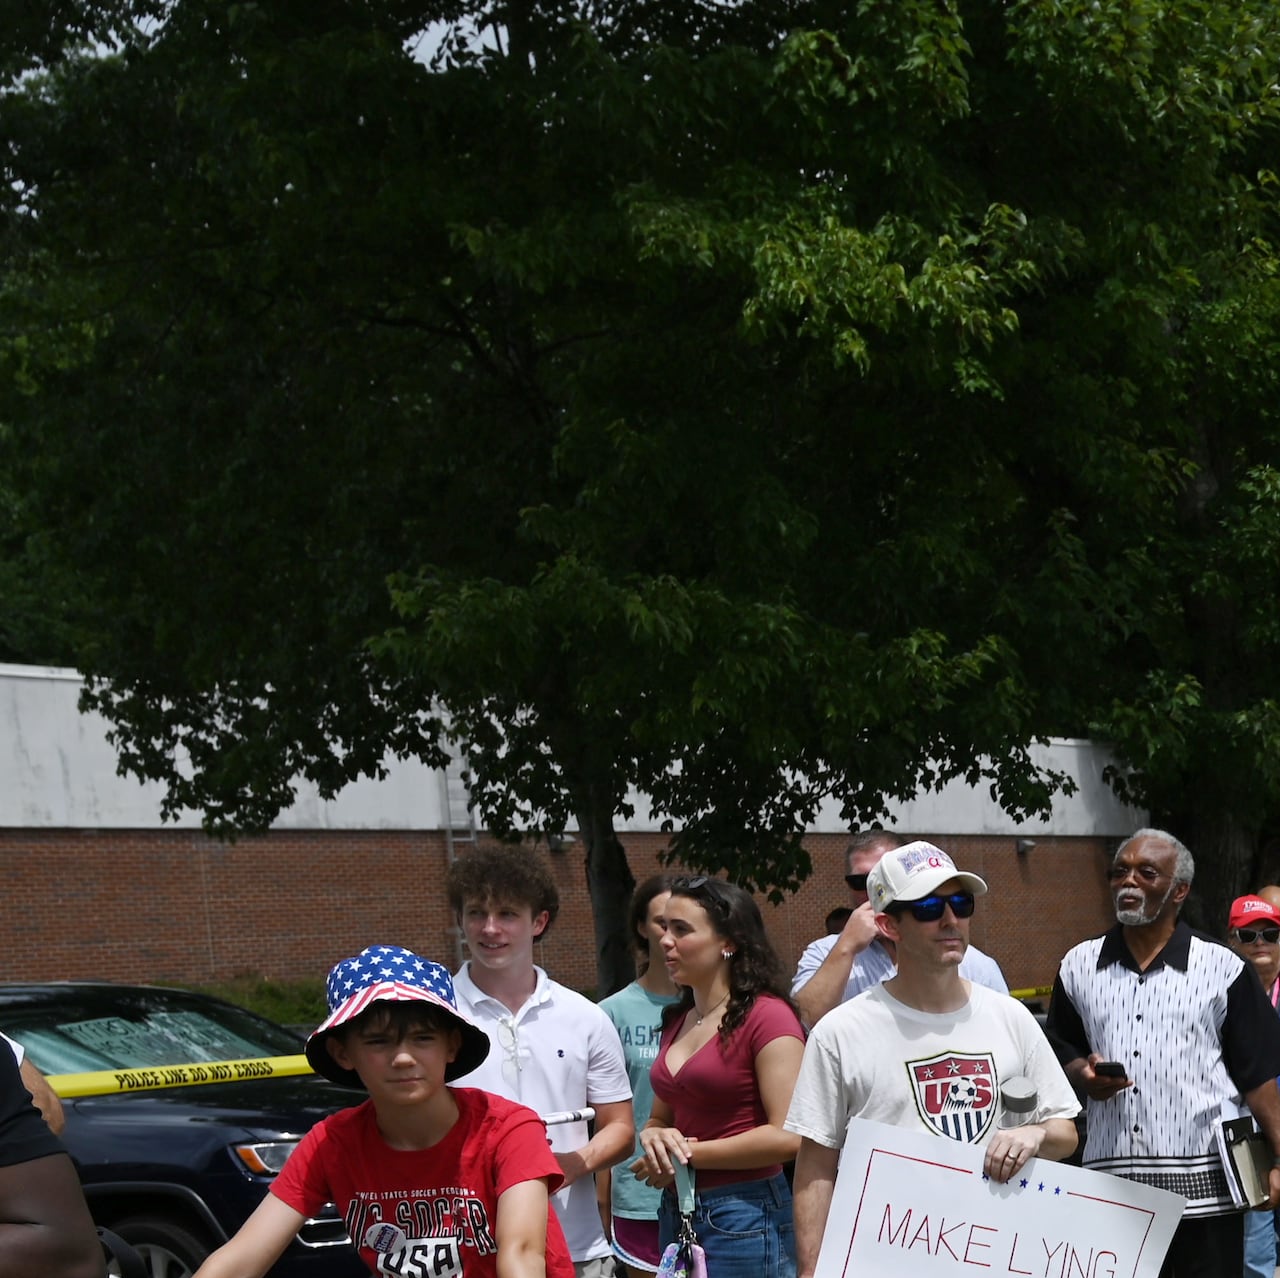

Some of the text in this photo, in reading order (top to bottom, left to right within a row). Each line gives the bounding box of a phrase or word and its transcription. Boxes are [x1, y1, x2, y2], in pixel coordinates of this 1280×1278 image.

[115, 1062, 273, 1089] POLICE LINE DO NOT CROSS
[878, 1203, 998, 1267] MAKE
